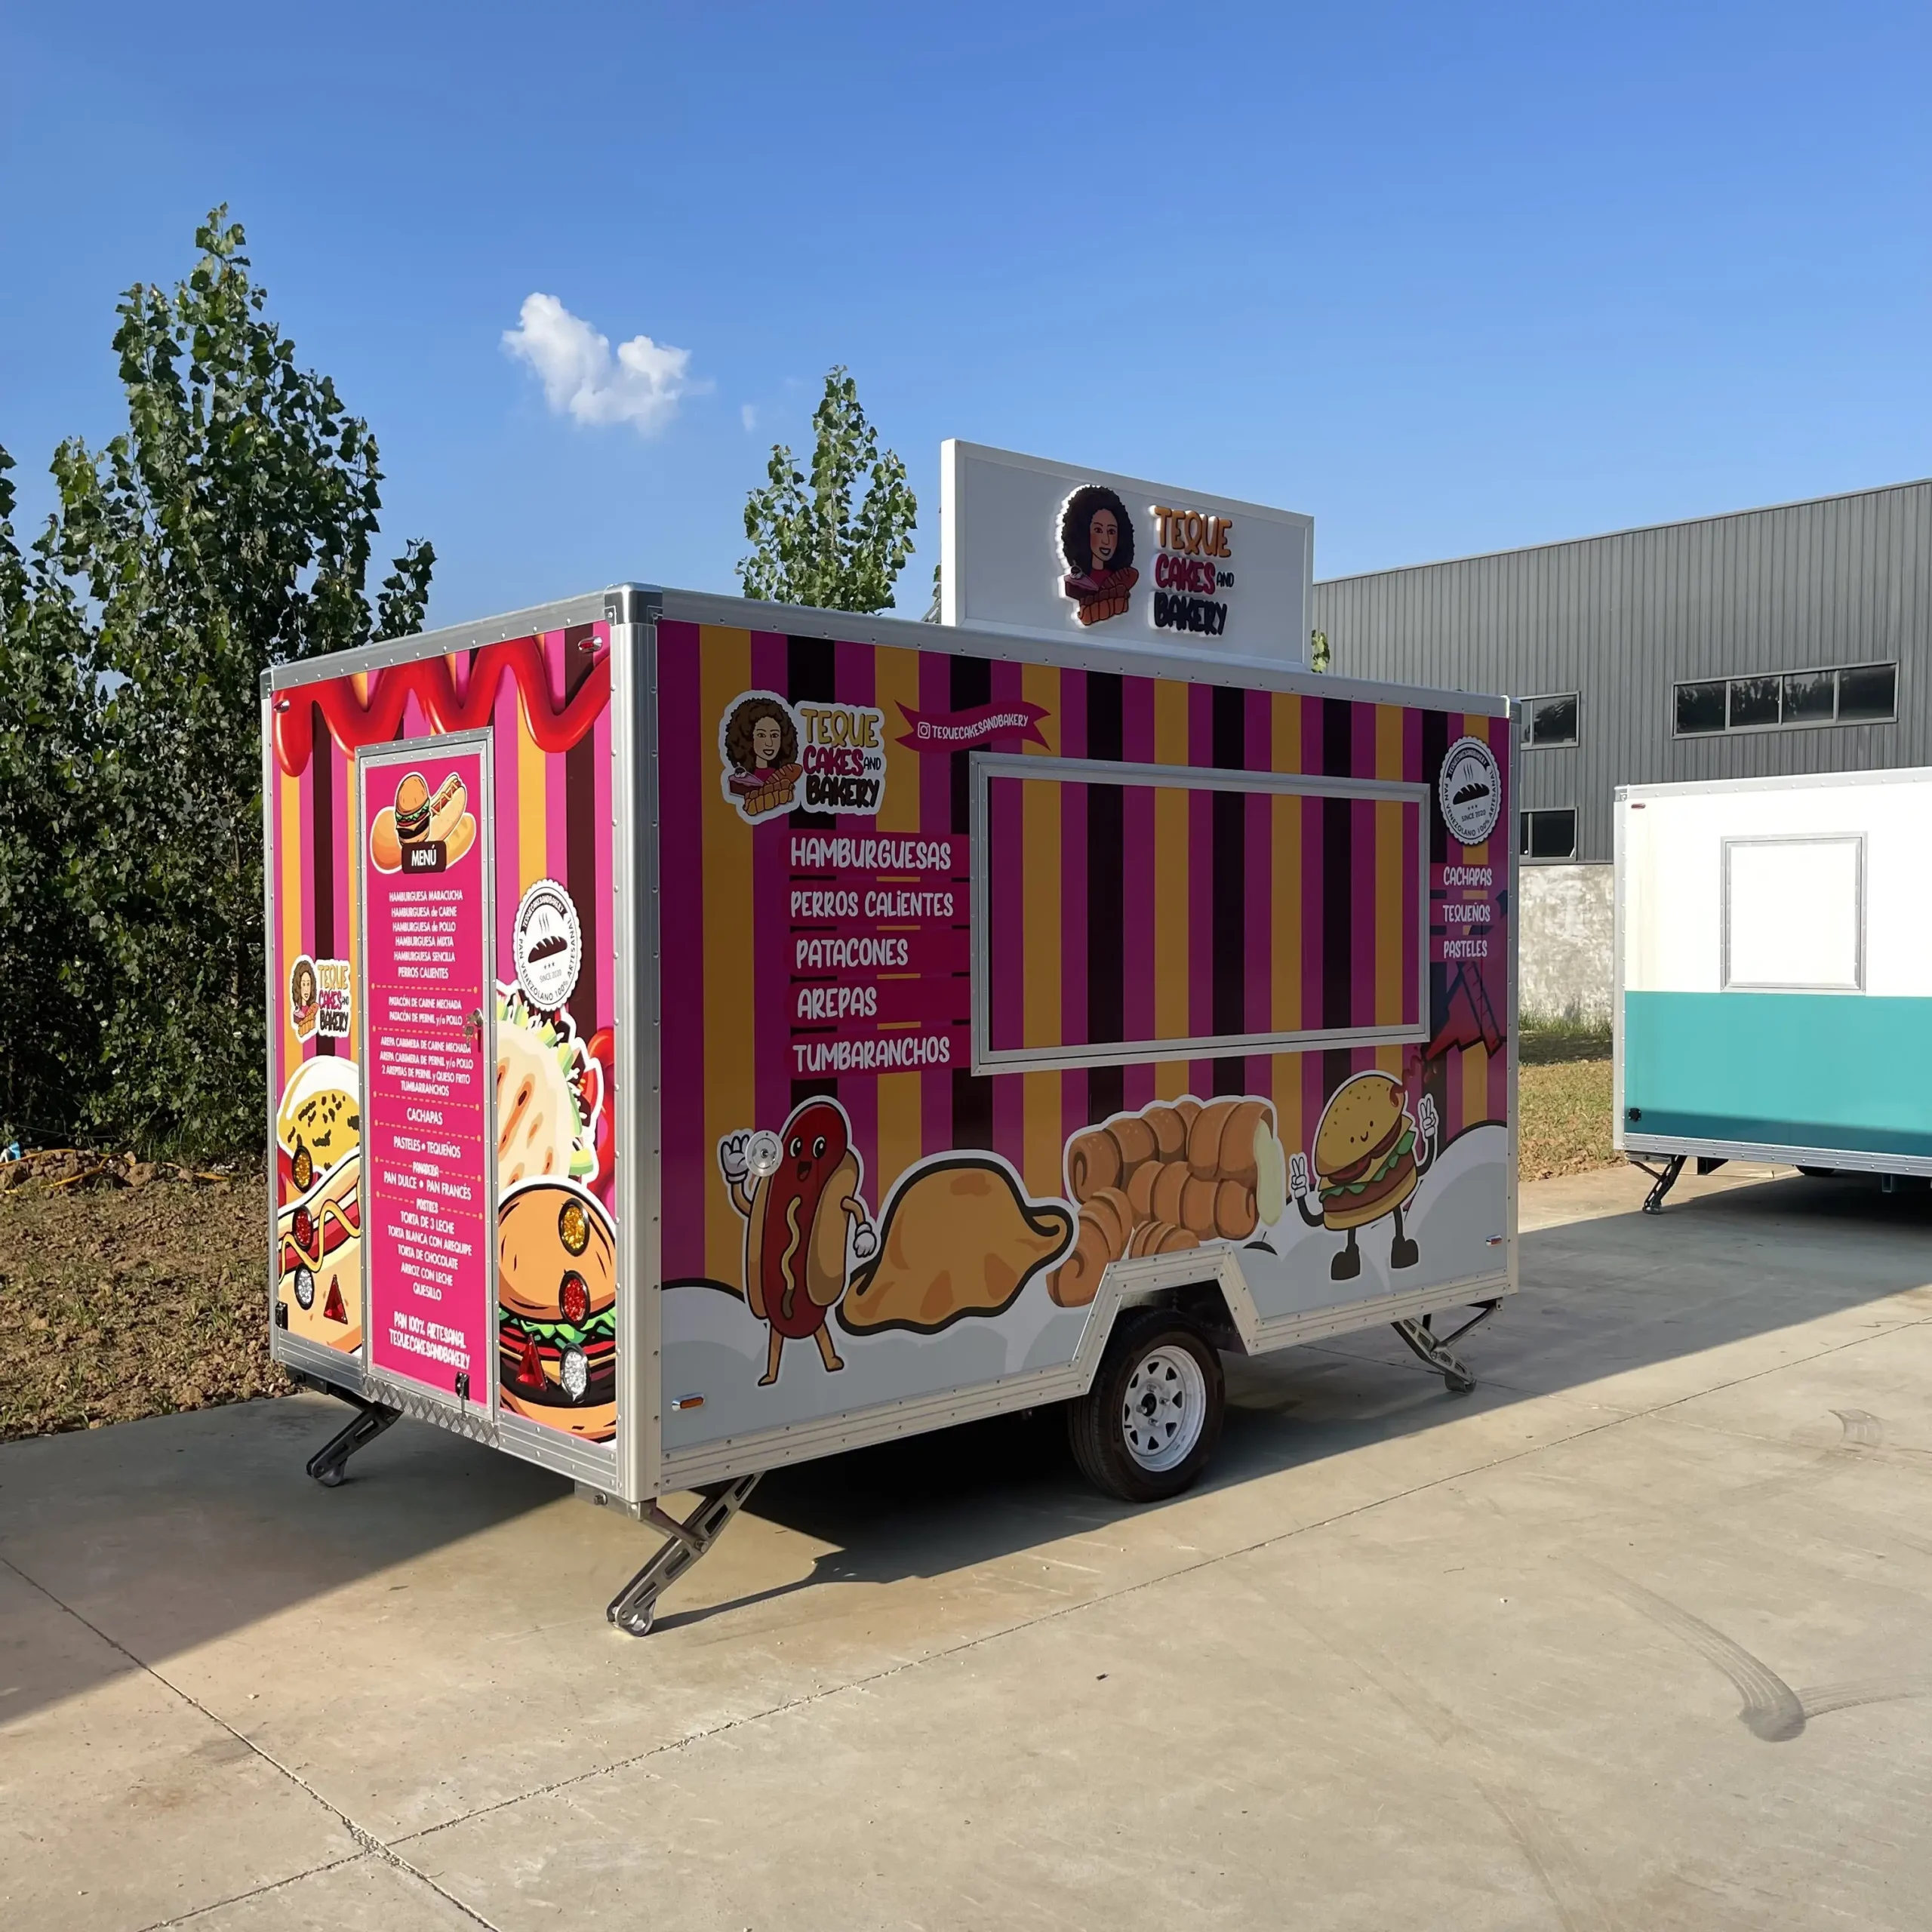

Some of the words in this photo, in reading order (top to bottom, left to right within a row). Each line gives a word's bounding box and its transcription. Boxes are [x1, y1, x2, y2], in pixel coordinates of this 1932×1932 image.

[1152, 506, 1232, 558] TEQUE
[1155, 553, 1216, 595] CAKES
[1216, 572, 1235, 587] AND
[1153, 592, 1227, 635] BAKERY
[800, 709, 879, 748] TEQUE
[932, 713, 1029, 740] TEQUECAKESANDBAKERY
[803, 745, 864, 777] CAKES
[863, 757, 881, 771] AND
[806, 774, 880, 808] BAKERY
[1445, 805, 1476, 837] VENEZOLANO
[1488, 770, 1497, 818] ARTESANAL
[1461, 812, 1475, 822] SINCE
[411, 844, 437, 866] MENÚ
[791, 837, 951, 871] HAMBURGUESAS
[1443, 866, 1492, 886] CACHAPAS
[389, 891, 427, 903] HAMBURGUESA
[428, 890, 463, 901] MARACUCHA
[791, 891, 858, 918] PERROS
[392, 907, 430, 918] HAMBURGUESA
[431, 908, 438, 917] de
[438, 906, 457, 917] CARNE
[1442, 902, 1491, 922] TEQUEÑOS
[392, 921, 430, 932] HAMBURGUESA
[432, 922, 438, 932] de
[439, 921, 456, 932] POLLO
[395, 936, 435, 947] HAMBURGUESA
[436, 936, 454, 947] MIXTA
[1444, 940, 1487, 958] PASTELES
[394, 951, 431, 962] HAMBURGUESA
[432, 952, 455, 962] SENCILLA
[521, 961, 553, 1001] VENEZOLANO
[568, 917, 576, 978] ARTESANAL
[796, 937, 908, 969] PATACONES
[317, 964, 348, 989] TEQUE
[398, 967, 419, 979] PERROS
[540, 973, 552, 983] SINCE
[318, 989, 342, 1010] CAKES
[411, 998, 417, 1008] DE
[418, 998, 435, 1009] CARNE
[436, 999, 462, 1011] MECHADA
[797, 986, 877, 1020] AREPAS
[319, 1010, 348, 1032] BAKERY
[411, 1013, 417, 1022] DE
[419, 1014, 435, 1024] PERNIL
[446, 1015, 463, 1026] POLLO
[380, 1036, 395, 1046] AREPA
[420, 1039, 427, 1050] DE
[428, 1040, 445, 1051] CARNE
[792, 1036, 950, 1072] TUMBARANCHOS
[380, 1051, 394, 1062] AREPA
[420, 1054, 427, 1065] DE
[429, 1055, 445, 1067] PERNIL
[456, 1057, 473, 1069] POLLO
[381, 1065, 386, 1074] 2
[408, 1067, 414, 1077] DE
[415, 1068, 431, 1080] PERNIL
[436, 1070, 454, 1082] QUESO
[455, 1072, 470, 1084] FRITO
[401, 1081, 449, 1097] TUMBARRANCHOS
[407, 1107, 443, 1125] CACHAPAS
[393, 1136, 420, 1152] PASTELES
[426, 1141, 460, 1158] TEQUEÑOS
[383, 1171, 397, 1186] PAN
[398, 1173, 417, 1189] DULCE
[426, 1180, 441, 1194] PAN
[441, 1183, 472, 1201] FRANCÉS
[400, 1211, 419, 1226] TORTA
[420, 1214, 429, 1229] DE
[429, 1216, 435, 1229] 3
[435, 1217, 454, 1235] LECHE
[387, 1225, 405, 1239] TORTA
[405, 1228, 428, 1244] BLANCA
[429, 1232, 442, 1247] CON
[443, 1235, 472, 1257] AREQUIPE
[398, 1244, 415, 1259] TORTA
[416, 1247, 423, 1260] DE
[424, 1249, 458, 1269] CHOCOLATE
[401, 1261, 420, 1277] ARROZ
[420, 1266, 435, 1281] CON
[435, 1268, 453, 1287] LECHE
[413, 1282, 441, 1301] QUESILLO
[394, 1310, 408, 1330] PAN
[408, 1315, 426, 1335] 100%
[426, 1321, 466, 1349] ARTESANAL
